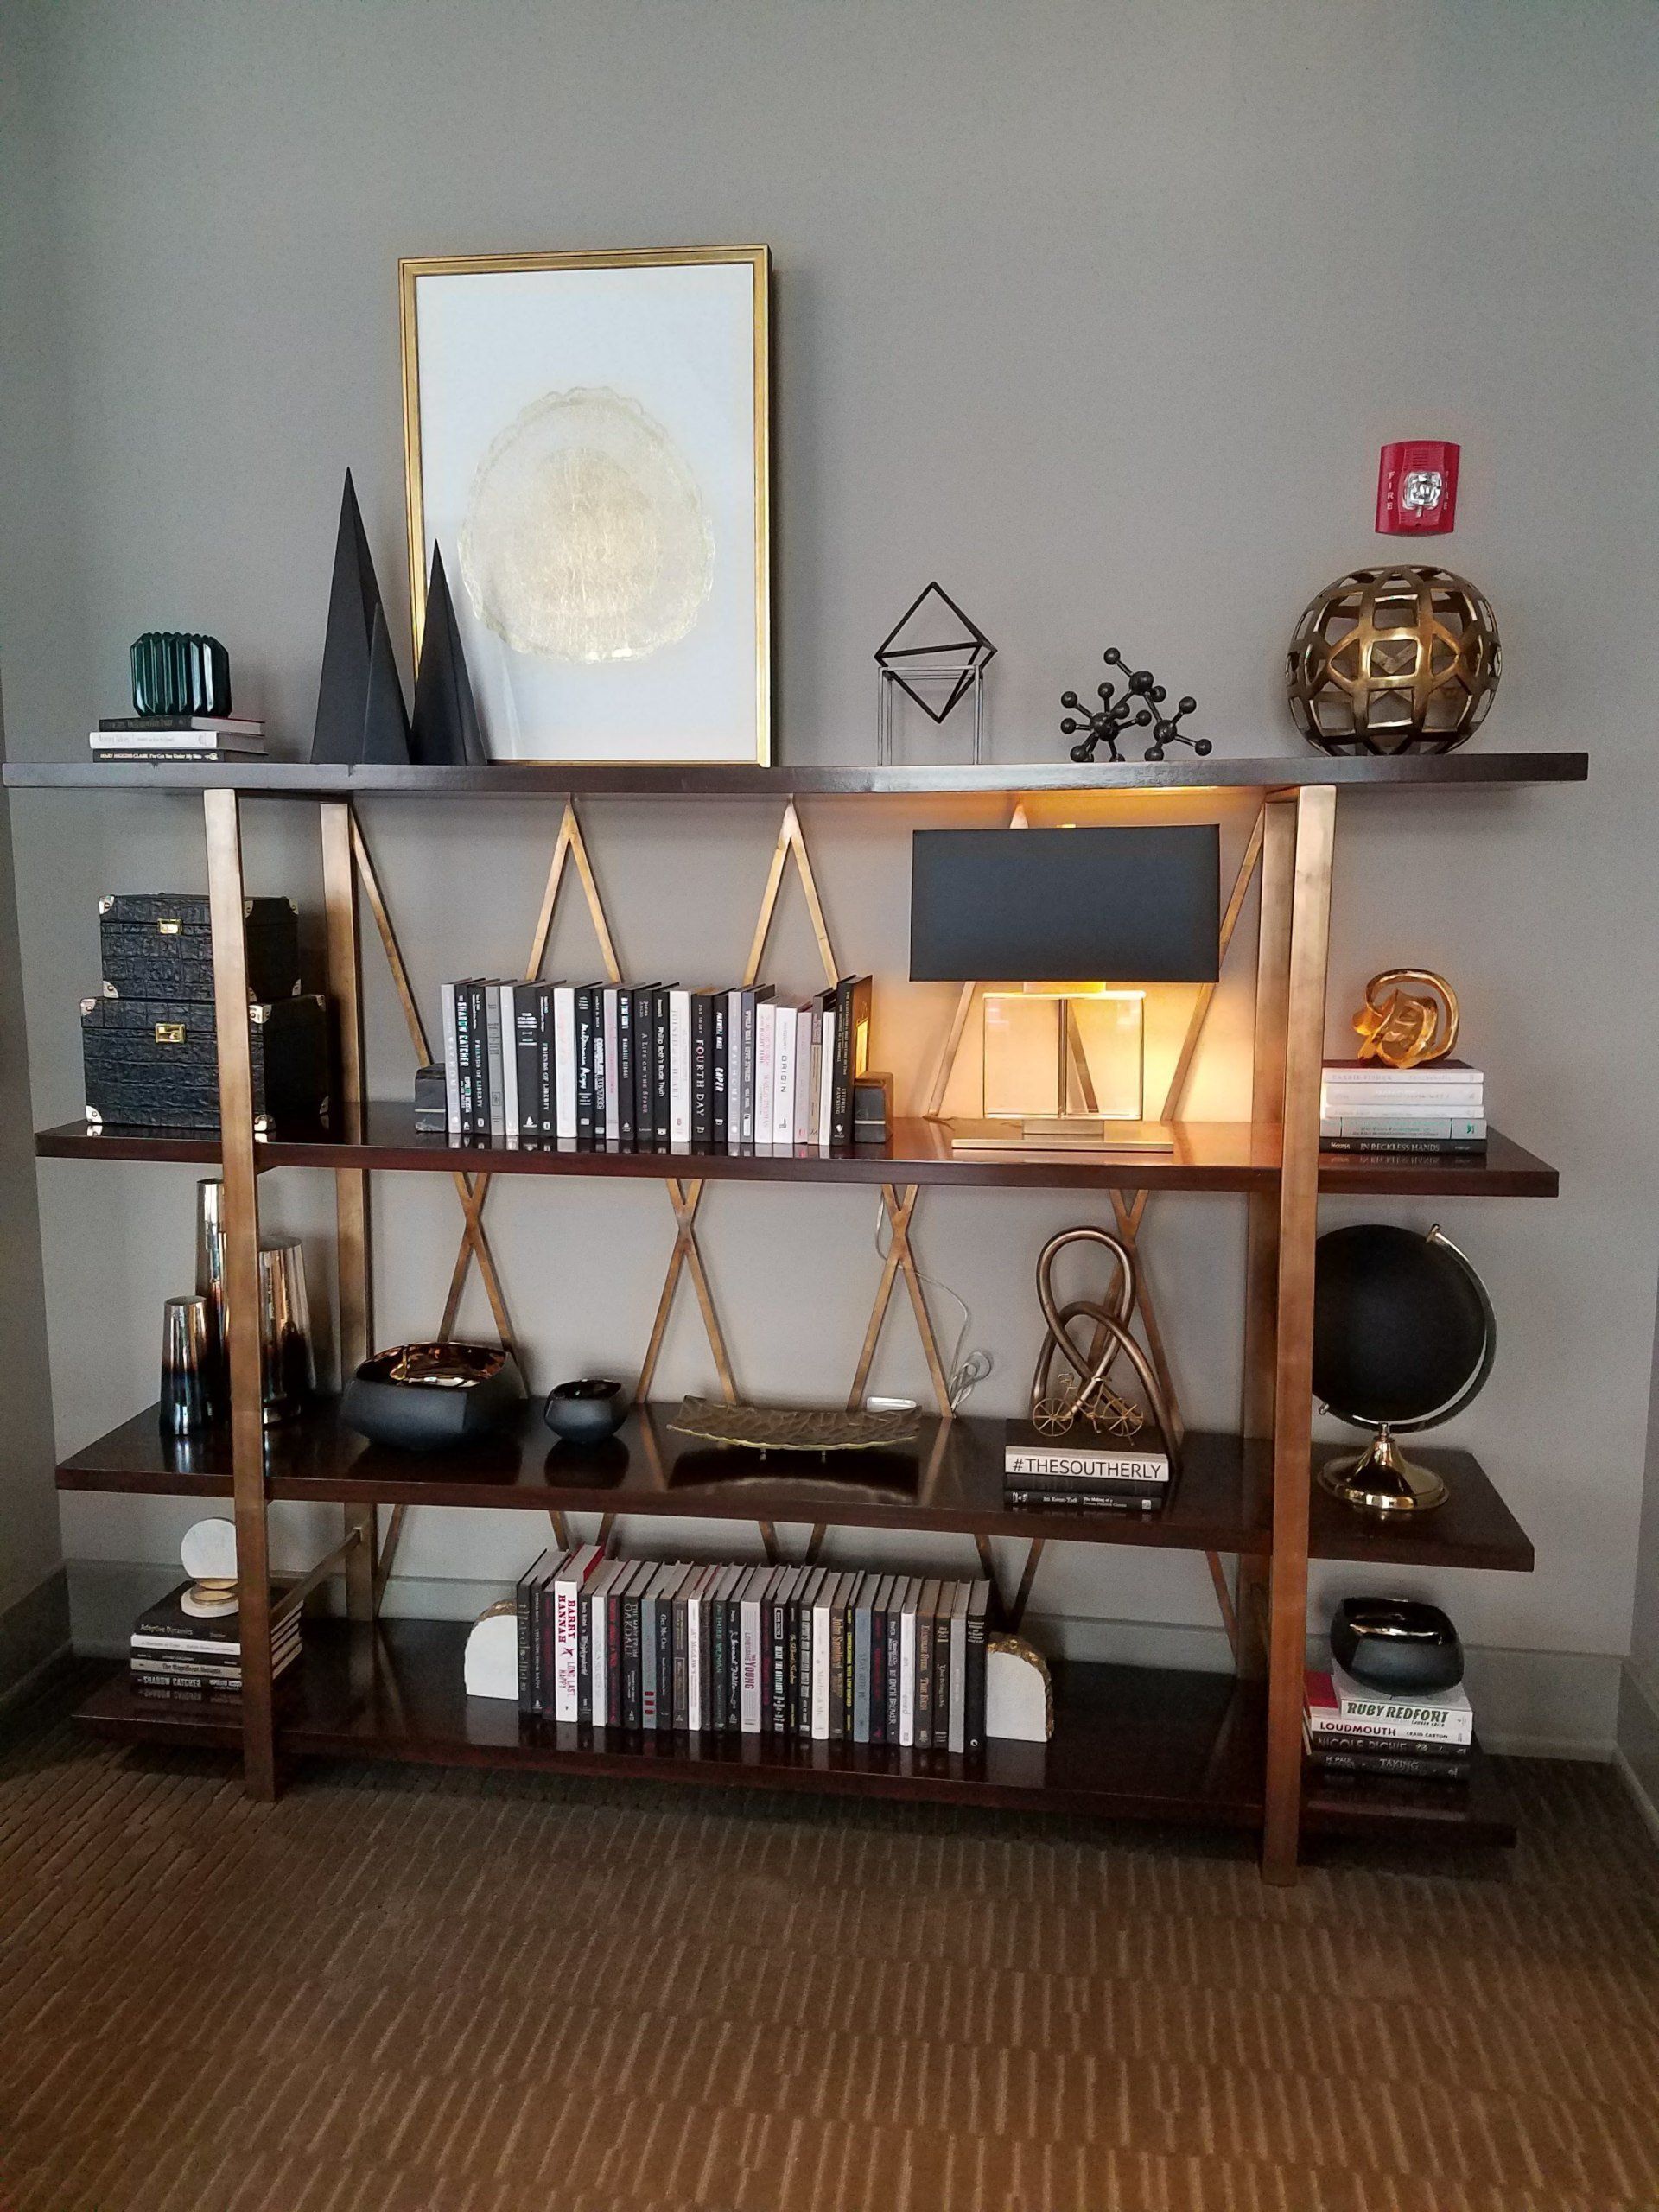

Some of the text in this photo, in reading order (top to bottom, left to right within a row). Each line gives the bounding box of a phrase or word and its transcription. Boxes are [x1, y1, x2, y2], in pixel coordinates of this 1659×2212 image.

[457, 1001, 470, 1066] SHADOW CATCHER
[475, 1070, 482, 1078] OF
[543, 1072, 550, 1081] OF
[696, 1039, 705, 1116] FOURTH DAY
[715, 1067, 724, 1091] CAPER
[1411, 1143, 1440, 1152] HANDS
[1012, 1458, 1162, 1479] #THESOUTHERLY
[568, 1599, 576, 1638] BARRY
[624, 1603, 632, 1658] OAKDALE
[660, 1626, 667, 1637] Me
[919, 1624, 930, 1653] DANIELLE
[832, 1617, 843, 1669] John Sandford
[774, 1661, 783, 1669] THE
[919, 1654, 930, 1671] STEEL
[143, 1675, 201, 1687] SHADOW CATCHER
[567, 1662, 575, 1696] LONG LAST
[730, 1666, 739, 1691] Fiddle
[745, 1662, 757, 1689] YOUNG
[919, 1677, 930, 1692] THE
[888, 1679, 897, 1725] OATH BREAKER
[1347, 1702, 1450, 1723] RUBY REDFORT
[1319, 1722, 1396, 1736] LOUDMOUTH
[1318, 1738, 1364, 1747] NICOLE
[1379, 1758, 1419, 1770] TAKING
